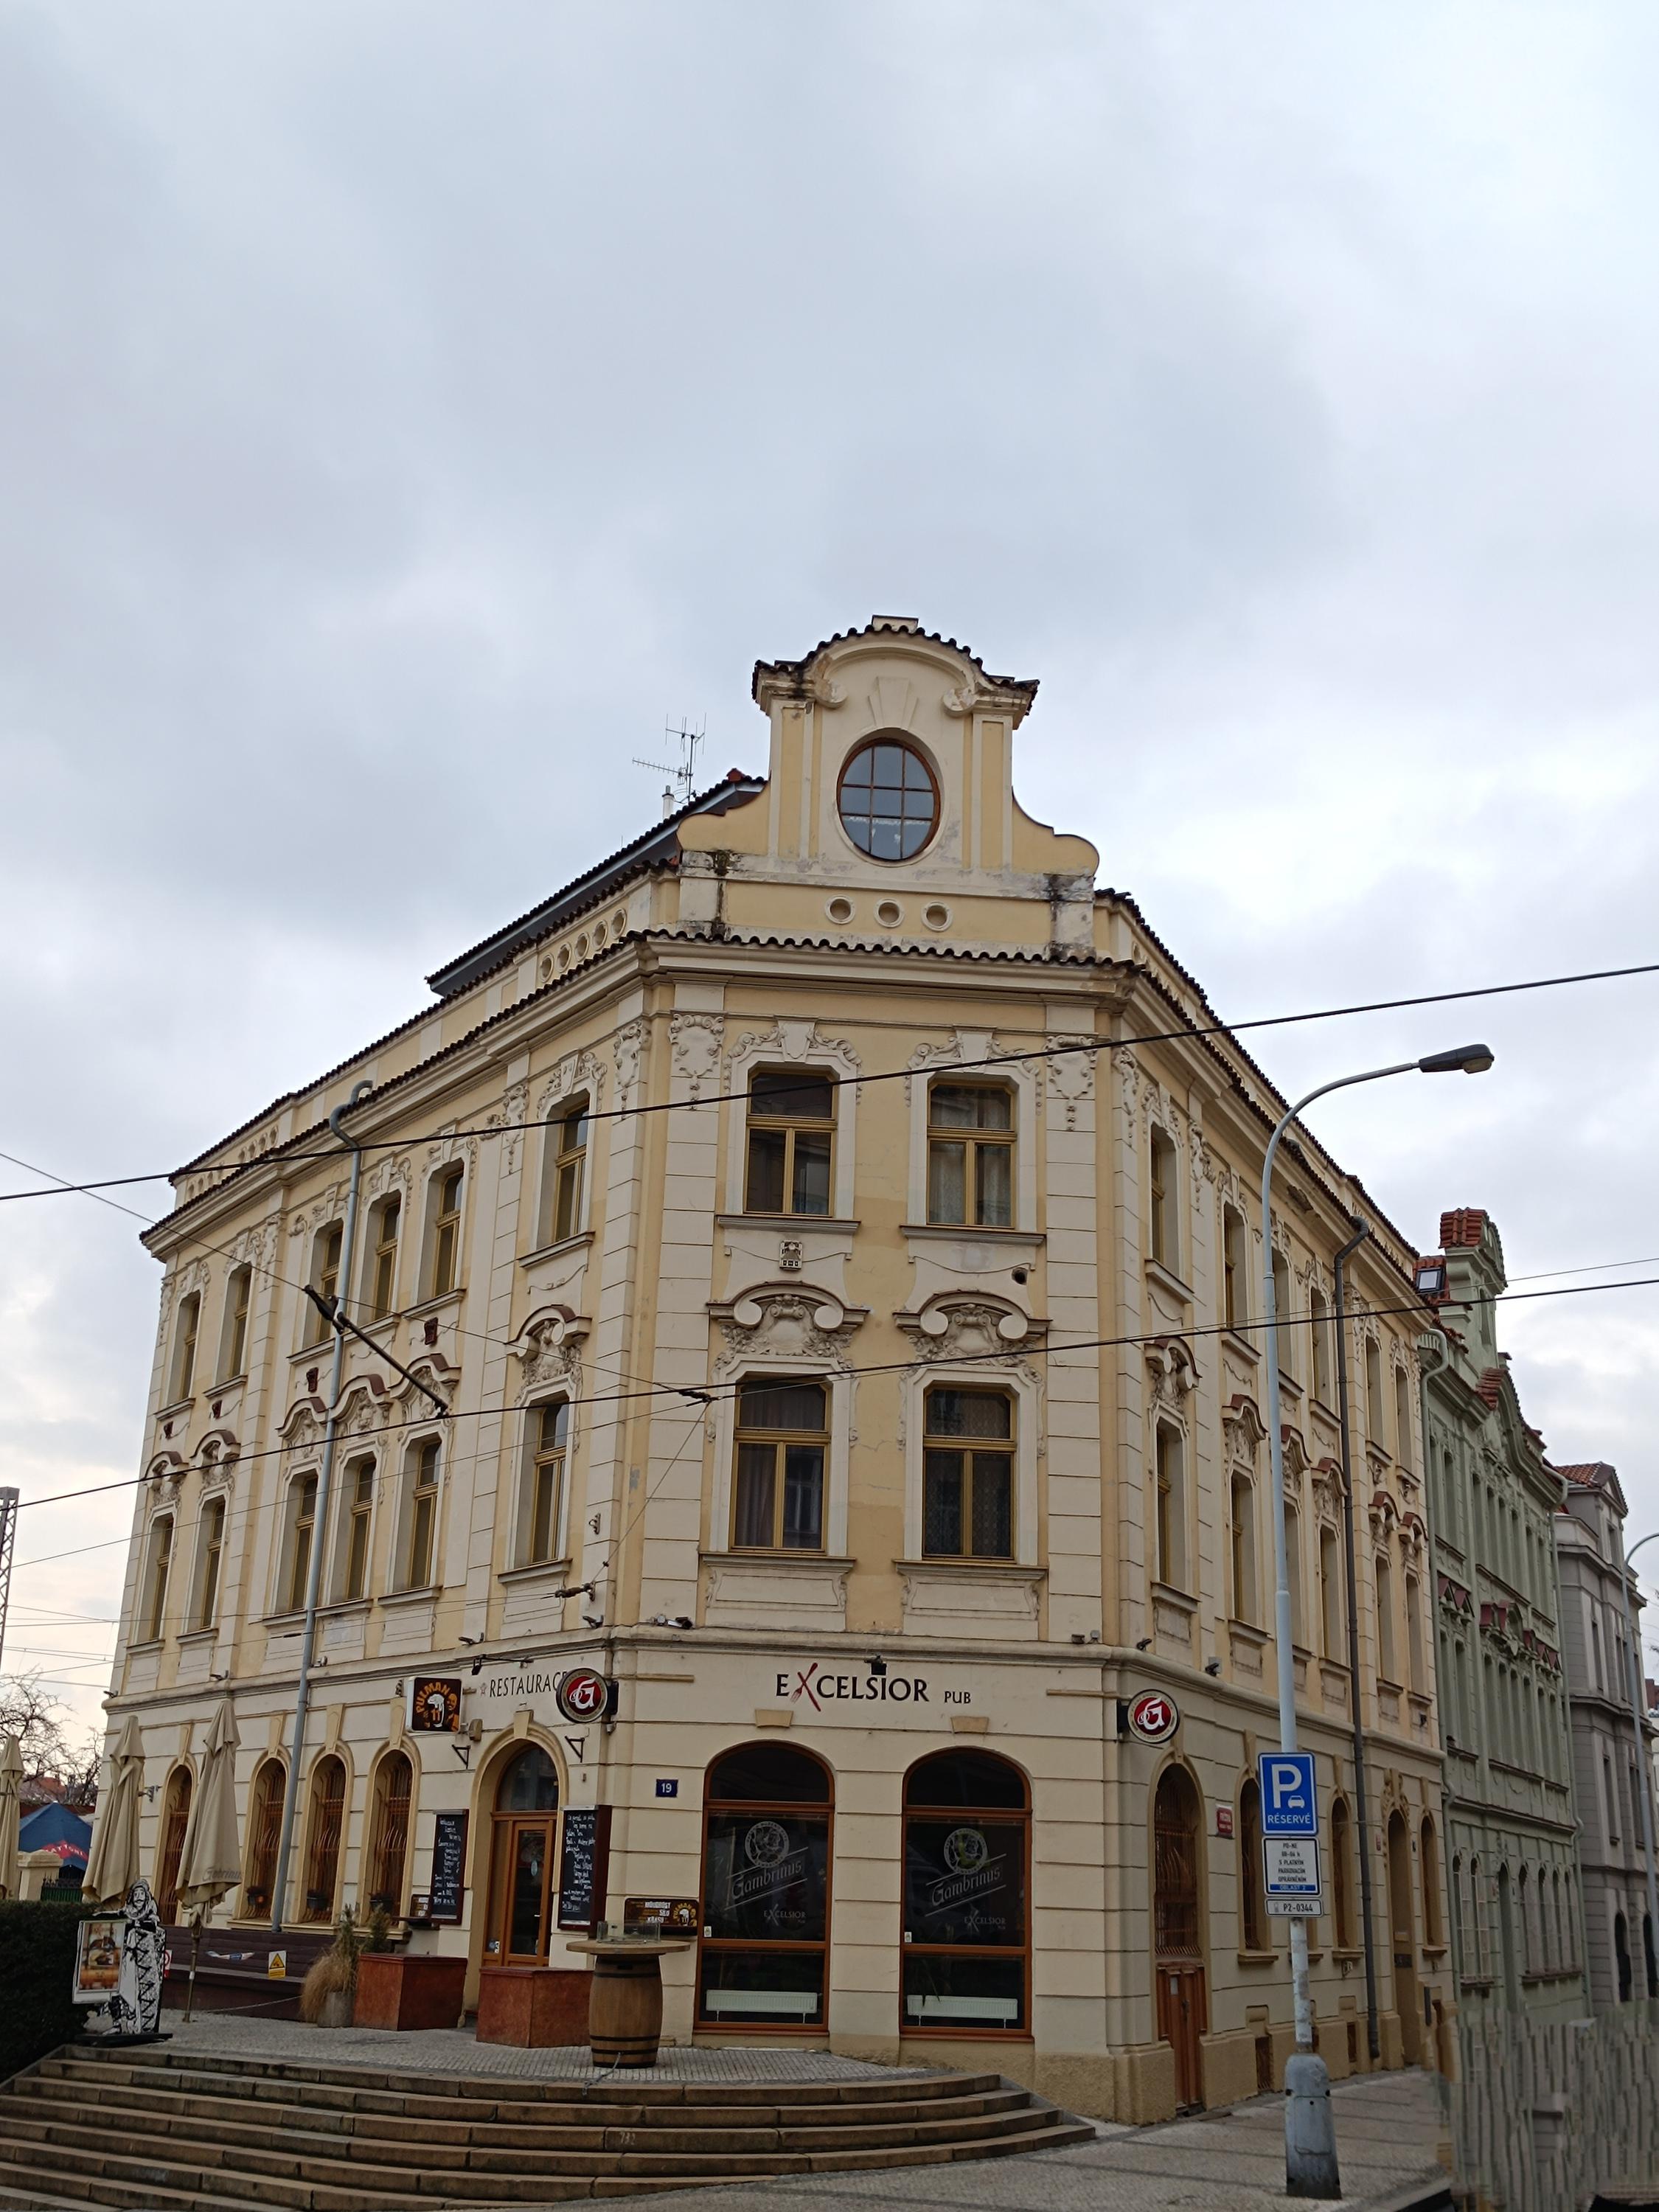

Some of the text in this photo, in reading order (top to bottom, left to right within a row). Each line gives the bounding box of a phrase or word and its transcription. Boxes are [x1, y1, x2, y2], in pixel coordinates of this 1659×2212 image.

[416, 1682, 451, 1714] PULMAN
[776, 1663, 971, 1711] EXCELSIOR PUB
[431, 1708, 440, 1721] 11
[661, 1783, 672, 1792] 19
[1271, 1763, 1302, 1809] P
[1267, 1812, 1311, 1824] RÉSERVÉ
[732, 1860, 802, 1900] Gambrinus
[931, 1866, 1001, 1906] Gambrinus
[1283, 1904, 1313, 1912] P2-0344
